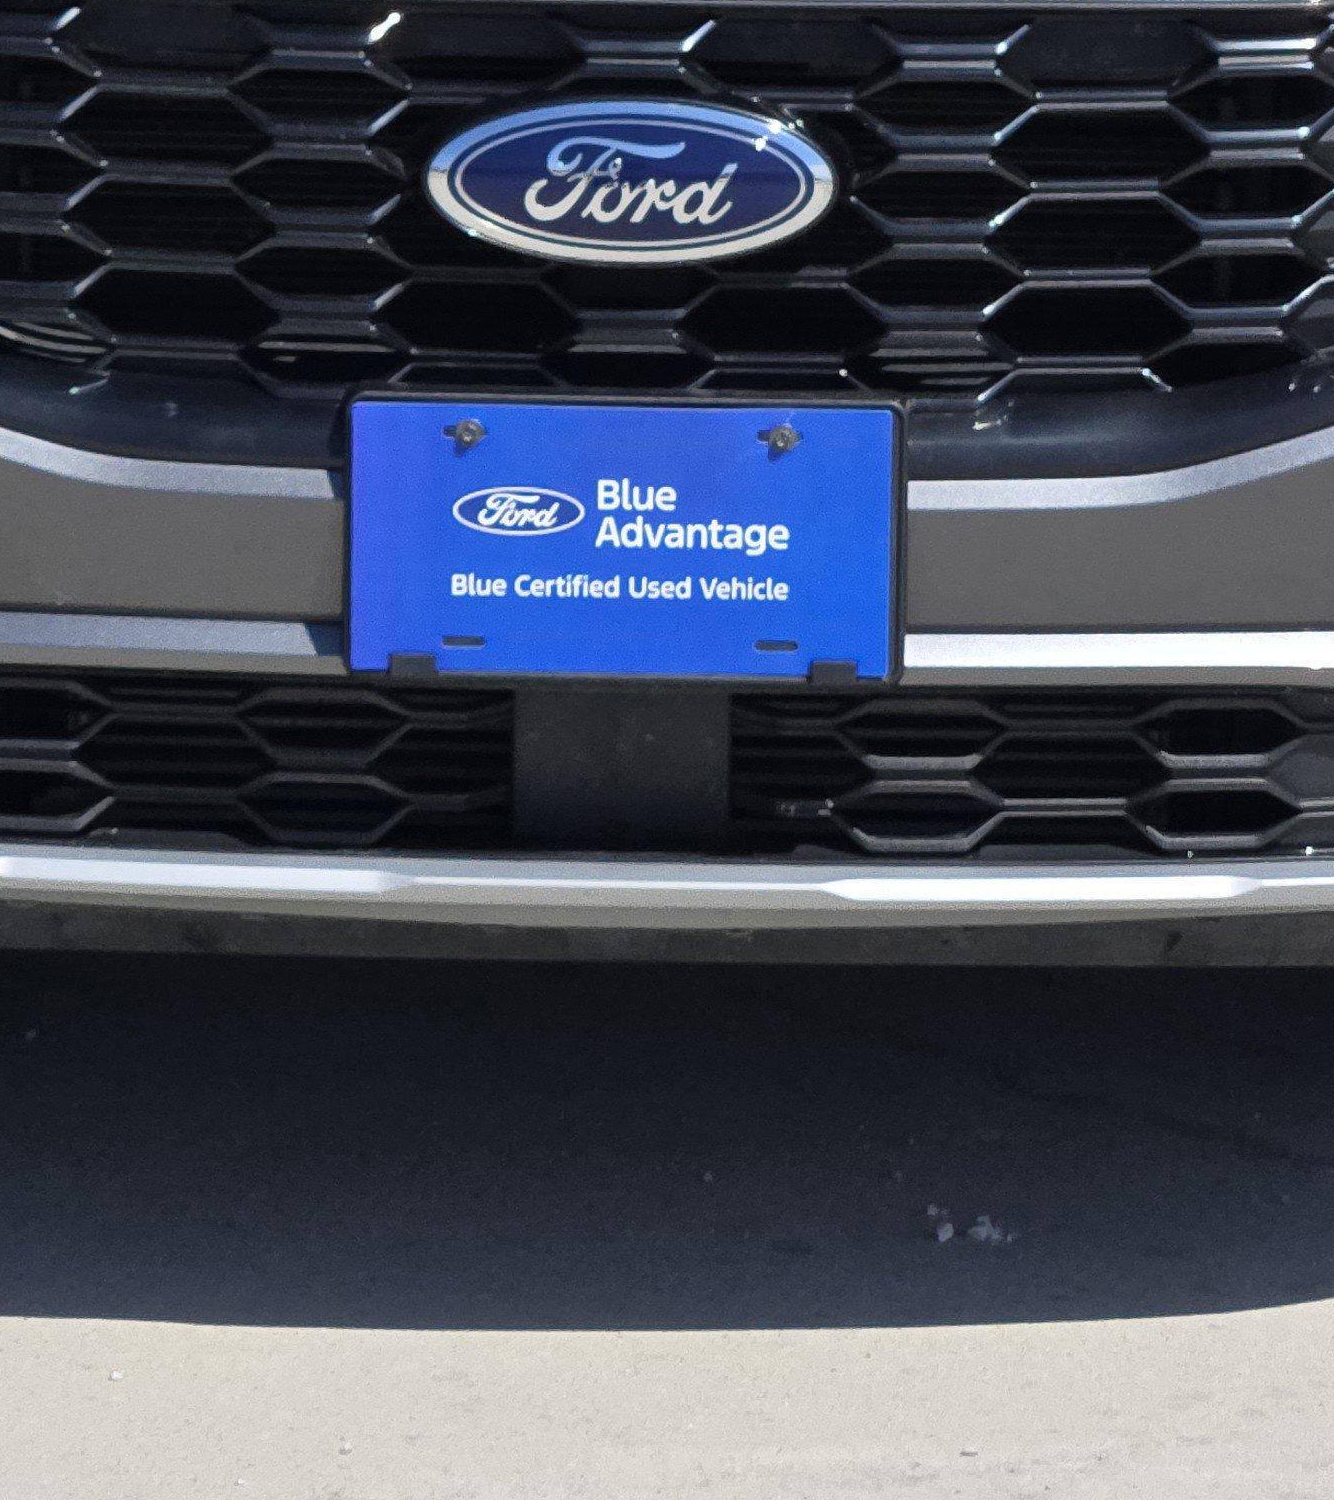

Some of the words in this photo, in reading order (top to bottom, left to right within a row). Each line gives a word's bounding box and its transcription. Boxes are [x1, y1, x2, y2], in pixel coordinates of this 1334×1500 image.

[523, 135, 738, 226] Ford
[477, 492, 560, 528] Ford
[597, 478, 678, 512] Blue
[595, 515, 791, 557] Advantage
[450, 572, 508, 597] Blue
[514, 573, 621, 599] Certified
[628, 575, 692, 600] Used
[699, 576, 790, 601] Vehicle
